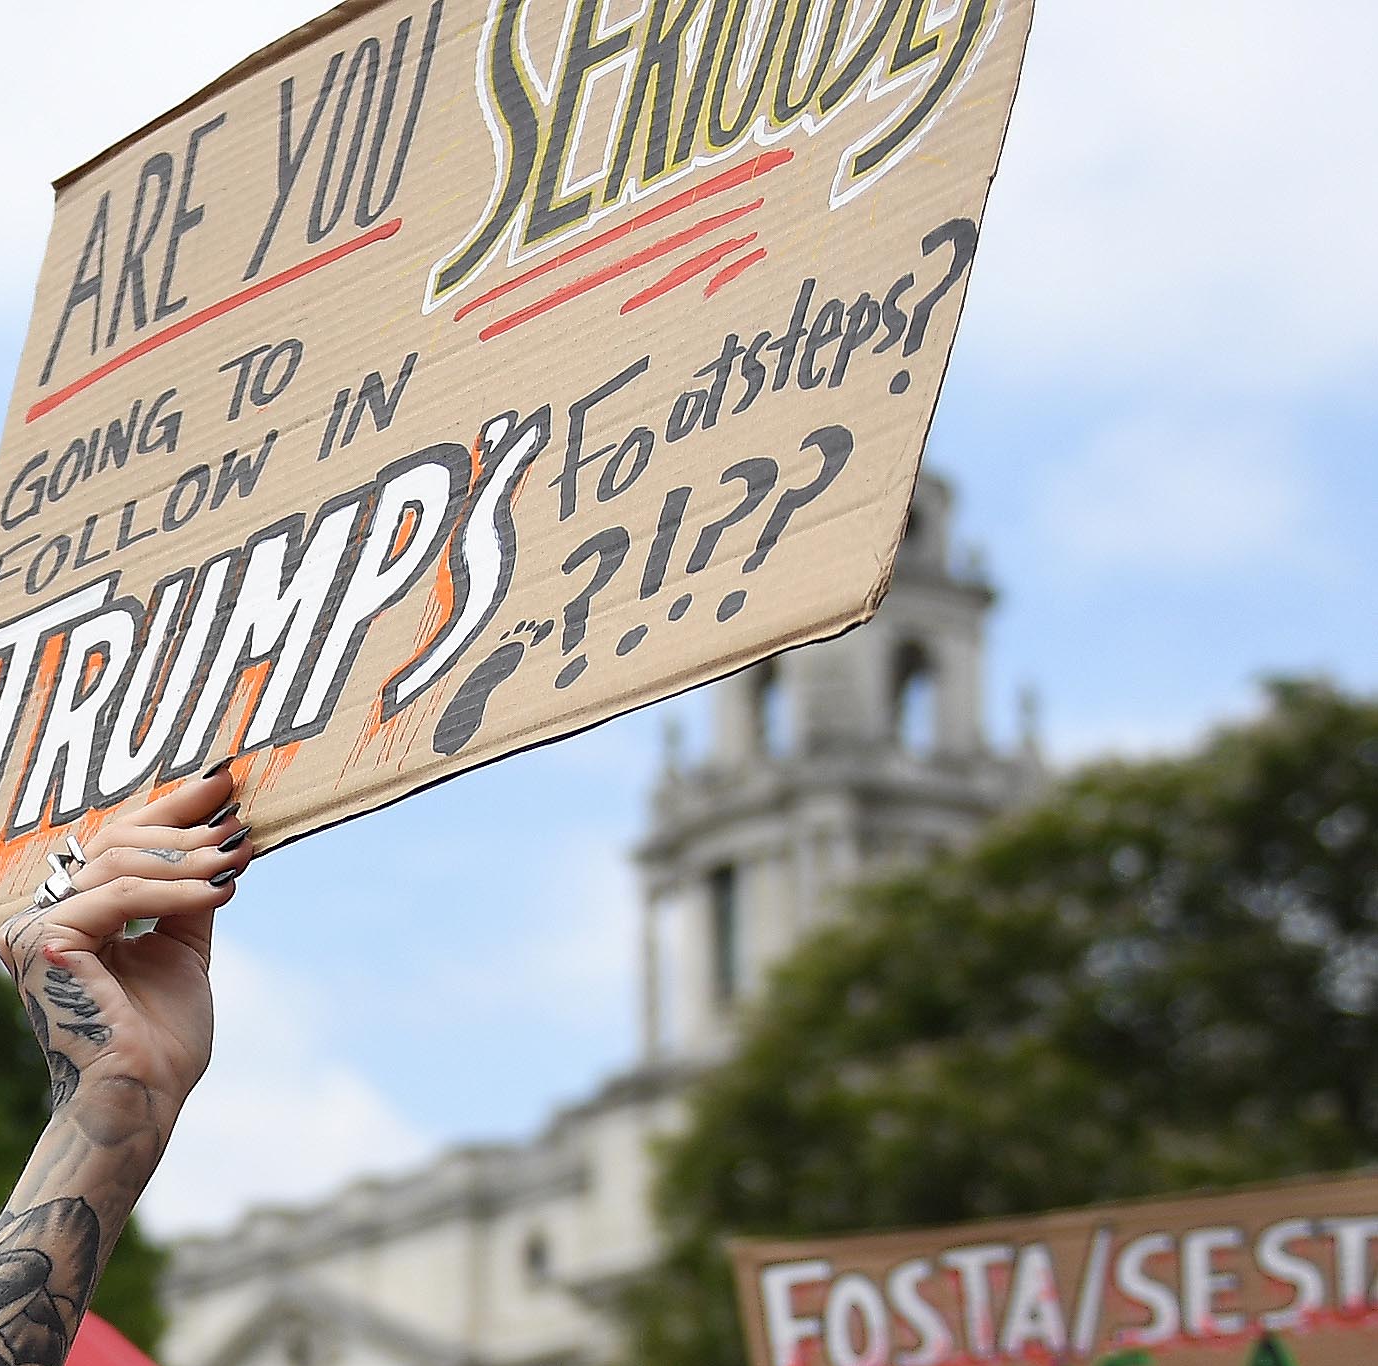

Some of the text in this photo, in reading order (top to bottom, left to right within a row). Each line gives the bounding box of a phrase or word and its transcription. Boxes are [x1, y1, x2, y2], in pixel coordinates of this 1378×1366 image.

[38, 112, 228, 387] ARE
[243, 0, 445, 282] YOU
[0, 338, 303, 532] GOING TO
[317, 351, 419, 461] IN
